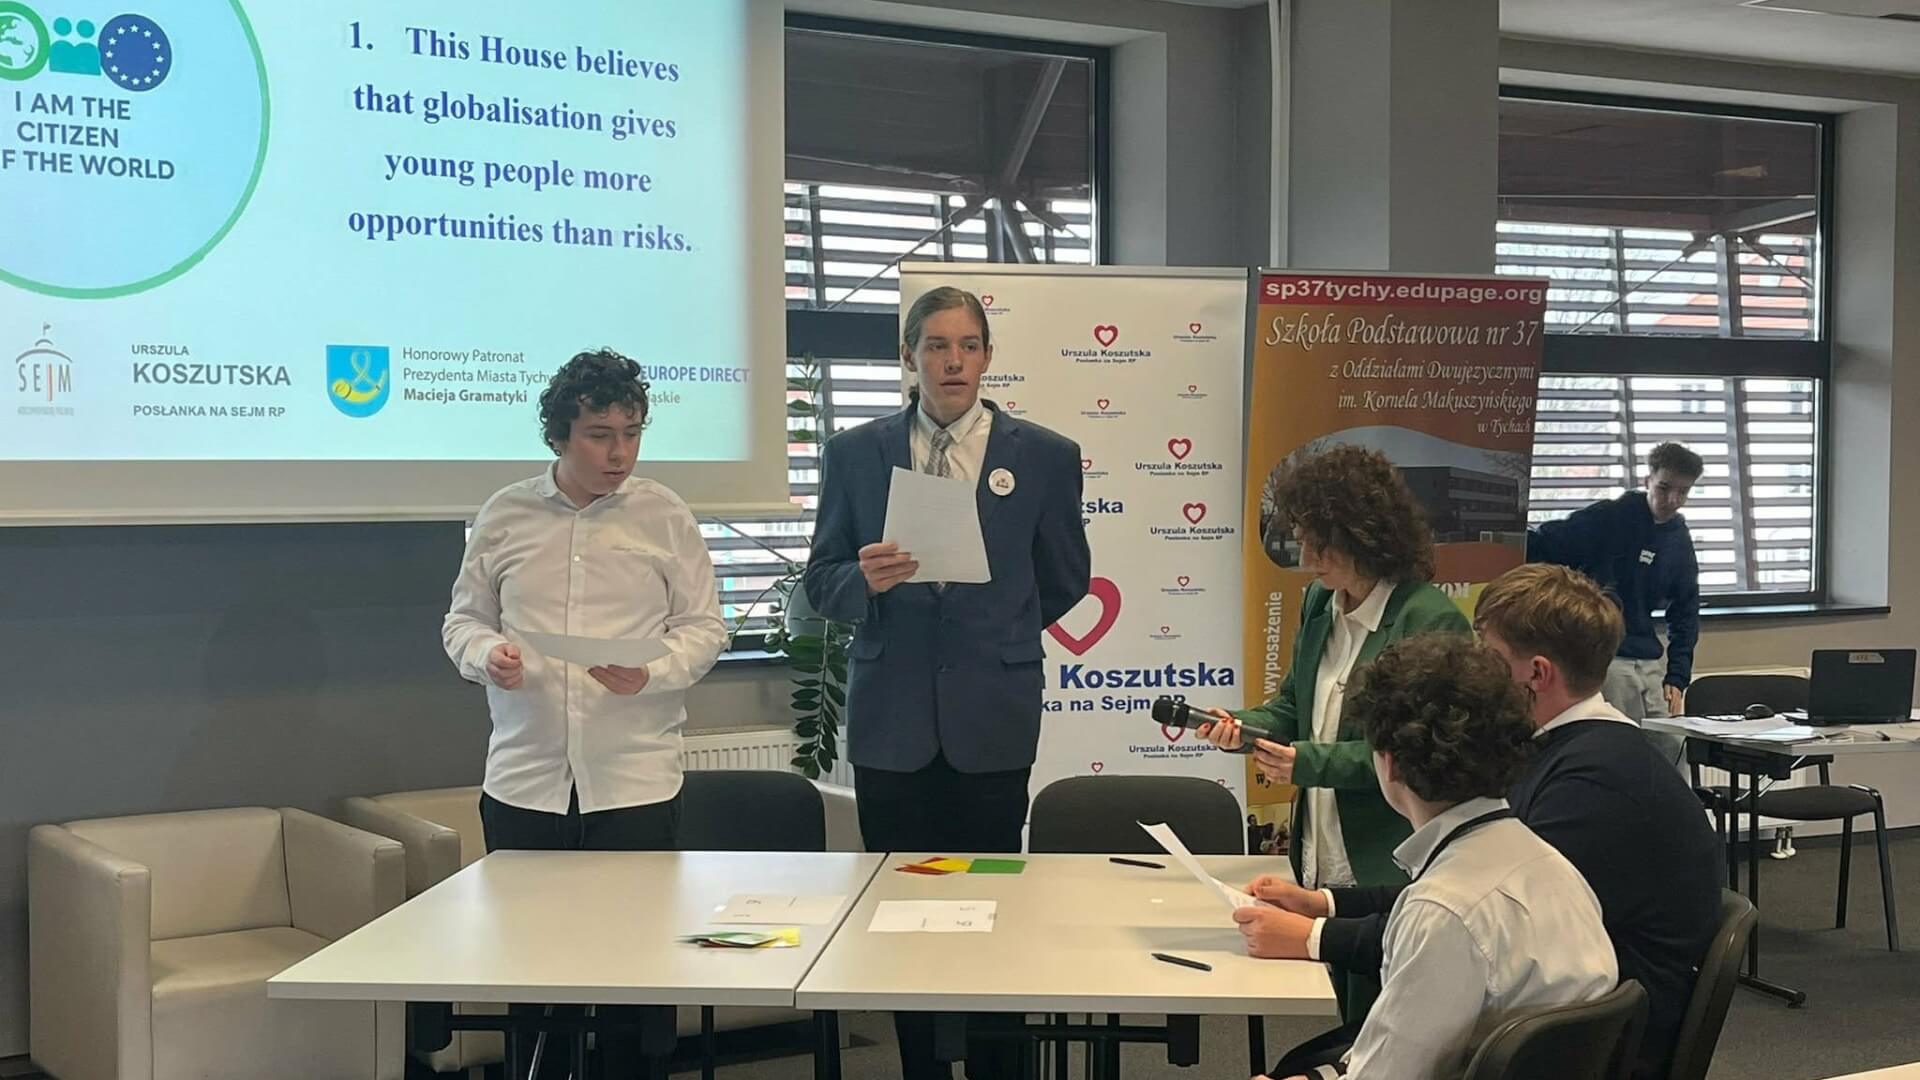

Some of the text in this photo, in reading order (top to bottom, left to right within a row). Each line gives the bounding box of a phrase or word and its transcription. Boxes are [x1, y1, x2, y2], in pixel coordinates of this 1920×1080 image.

[349, 21, 680, 82] 1. This House believes
[15, 90, 131, 121] I AM THE
[353, 83, 678, 141] that globalisation gives
[16, 121, 119, 149] CITIZEN
[23, 150, 73, 173] THE
[79, 153, 175, 180] WORLD
[384, 153, 653, 193] young people more
[348, 211, 693, 253] opportunities than risks.
[1265, 279, 1543, 305] sp37tychy.edupage.org
[1265, 313, 1539, 351] Szkoła Podstawowa nr 37
[131, 344, 190, 356] URSZULA
[402, 347, 525, 365] Honorowy Patronat
[1061, 348, 1151, 358] Urszula Koszutska
[133, 362, 292, 386] KOSZUTSKA
[403, 367, 474, 385] Prezydenta
[476, 370, 518, 383] Miasta
[640, 365, 750, 383] EUROPE DIRECT
[981, 373, 1025, 382] oszutska
[1328, 357, 1535, 385] z Oddziałami Dwujęzycznymi
[403, 388, 528, 406] Macieja Gramatyki
[1338, 388, 1533, 416] im. Kornela Makuszyńskiego
[133, 404, 286, 418] POSŁANKA NA SEJM RP
[1477, 418, 1532, 438] w Tychach
[1135, 461, 1223, 470] Urszula Koszutska
[1150, 526, 1235, 535] Urszula Koszutska
[1262, 591, 1283, 695] wyposażenie
[1059, 662, 1235, 689] Koszutska
[1070, 699, 1094, 712] na
[1101, 695, 1151, 714] Sejm
[1129, 744, 1218, 753] Urszula Koszutska
